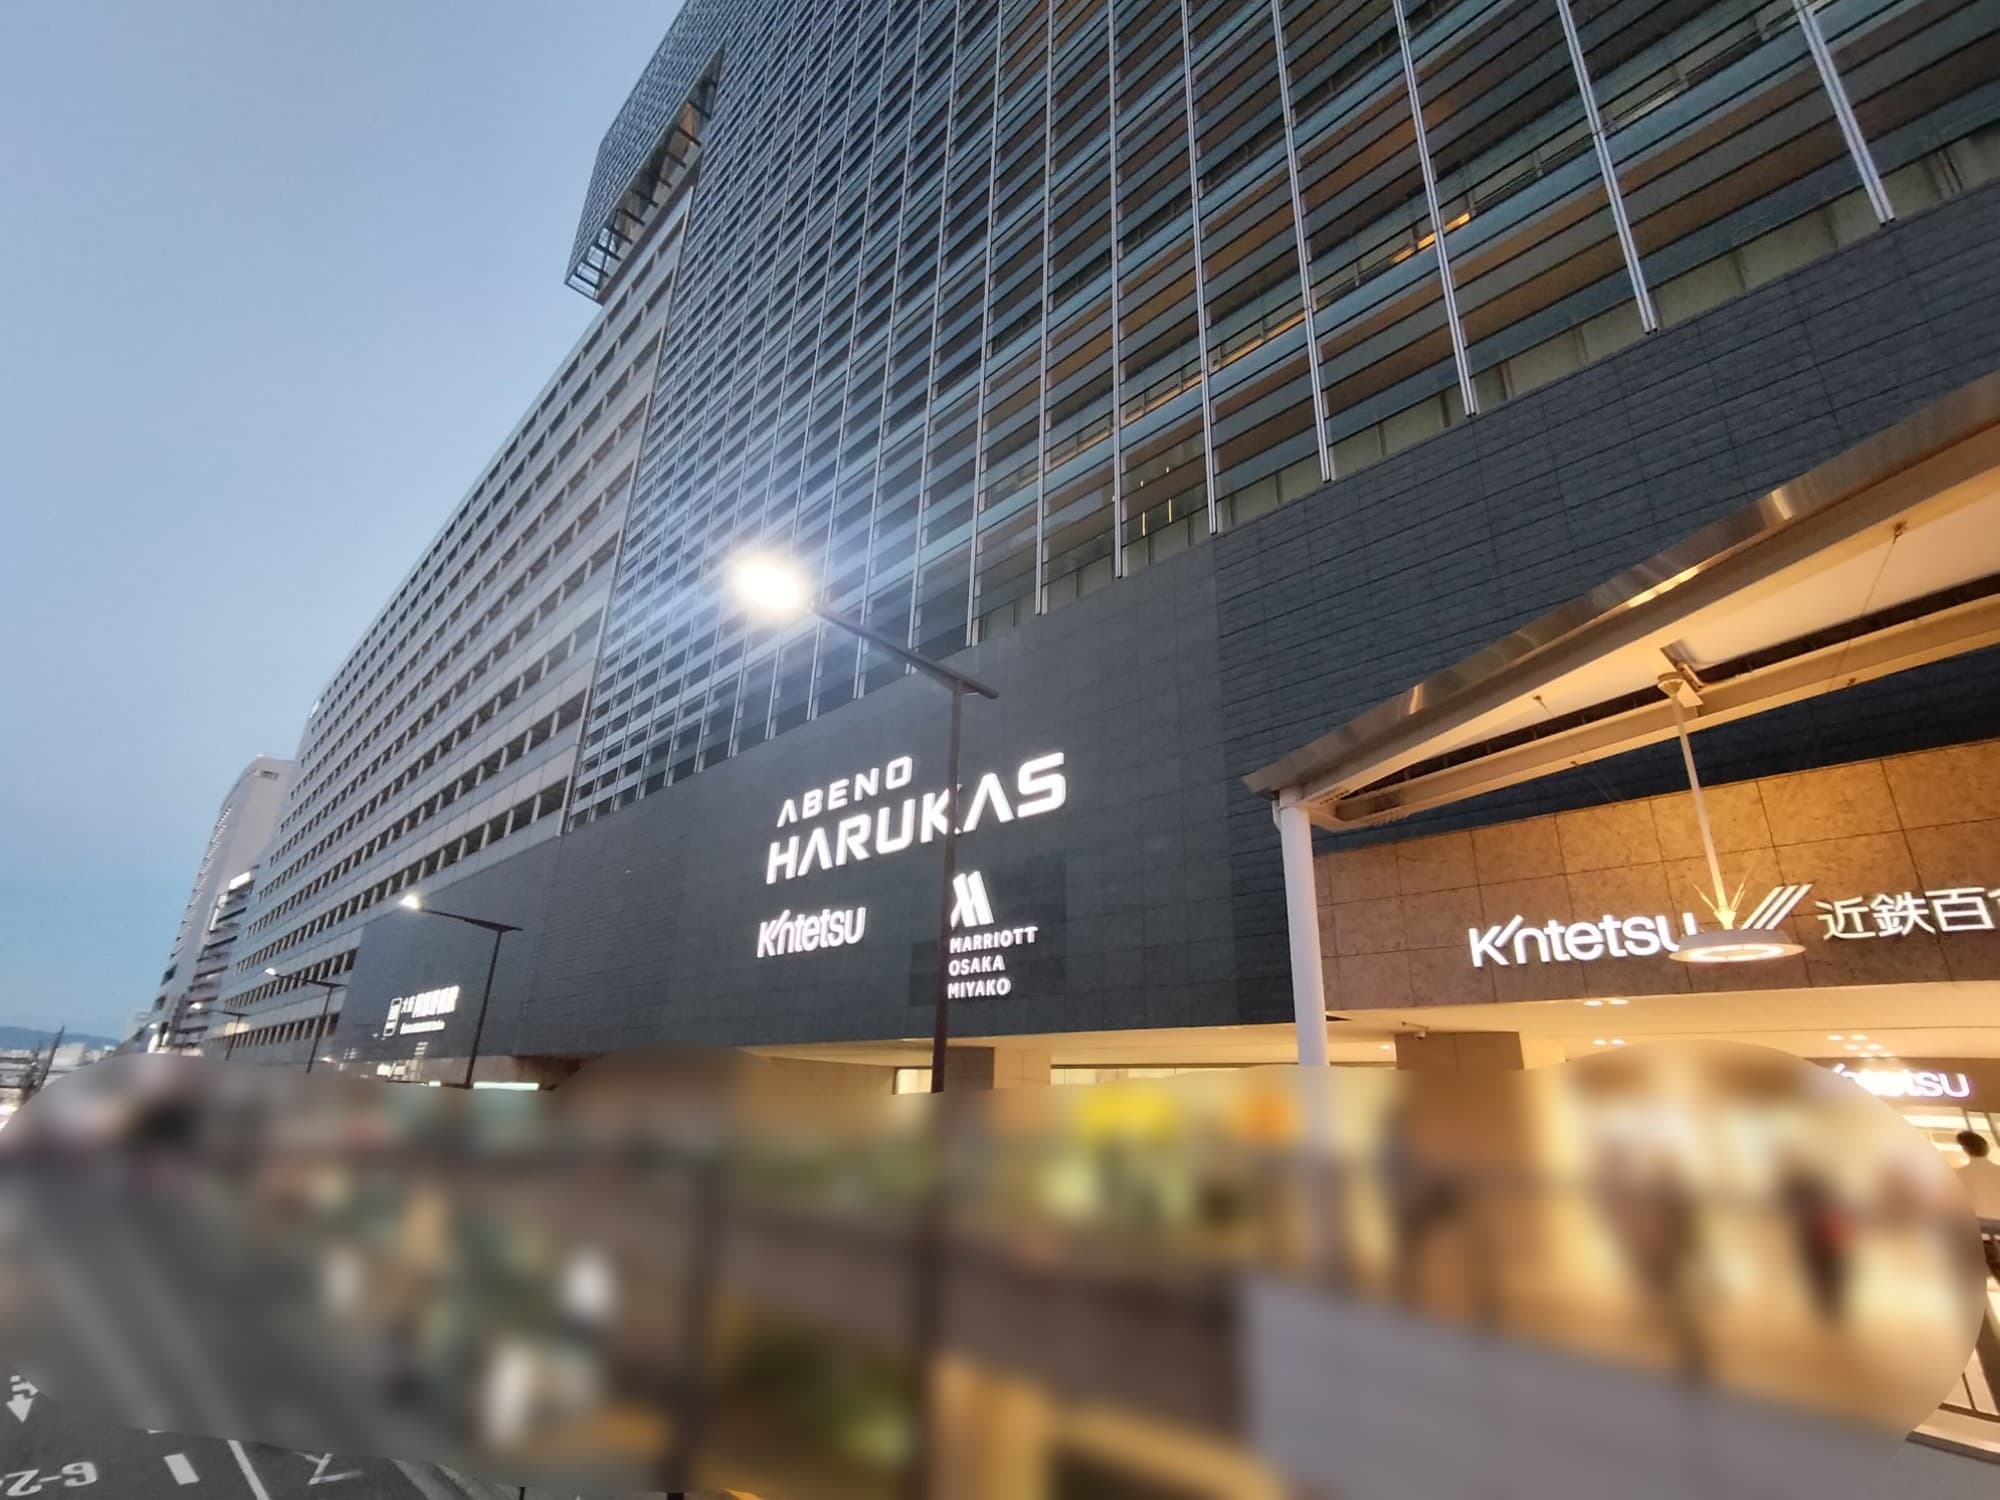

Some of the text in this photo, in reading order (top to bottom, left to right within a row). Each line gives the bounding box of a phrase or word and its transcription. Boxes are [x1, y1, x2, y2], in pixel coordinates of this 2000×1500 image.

[777, 756, 912, 827] ABENO
[766, 752, 1066, 884] HARUKAS
[1817, 886, 2000, 940] 近鉄百
[950, 926, 1038, 953] MARRIOTT
[949, 955, 1005, 976] OSAKA
[948, 978, 1011, 999] MIYAKO
[0, 1461, 97, 1496] 6-2
